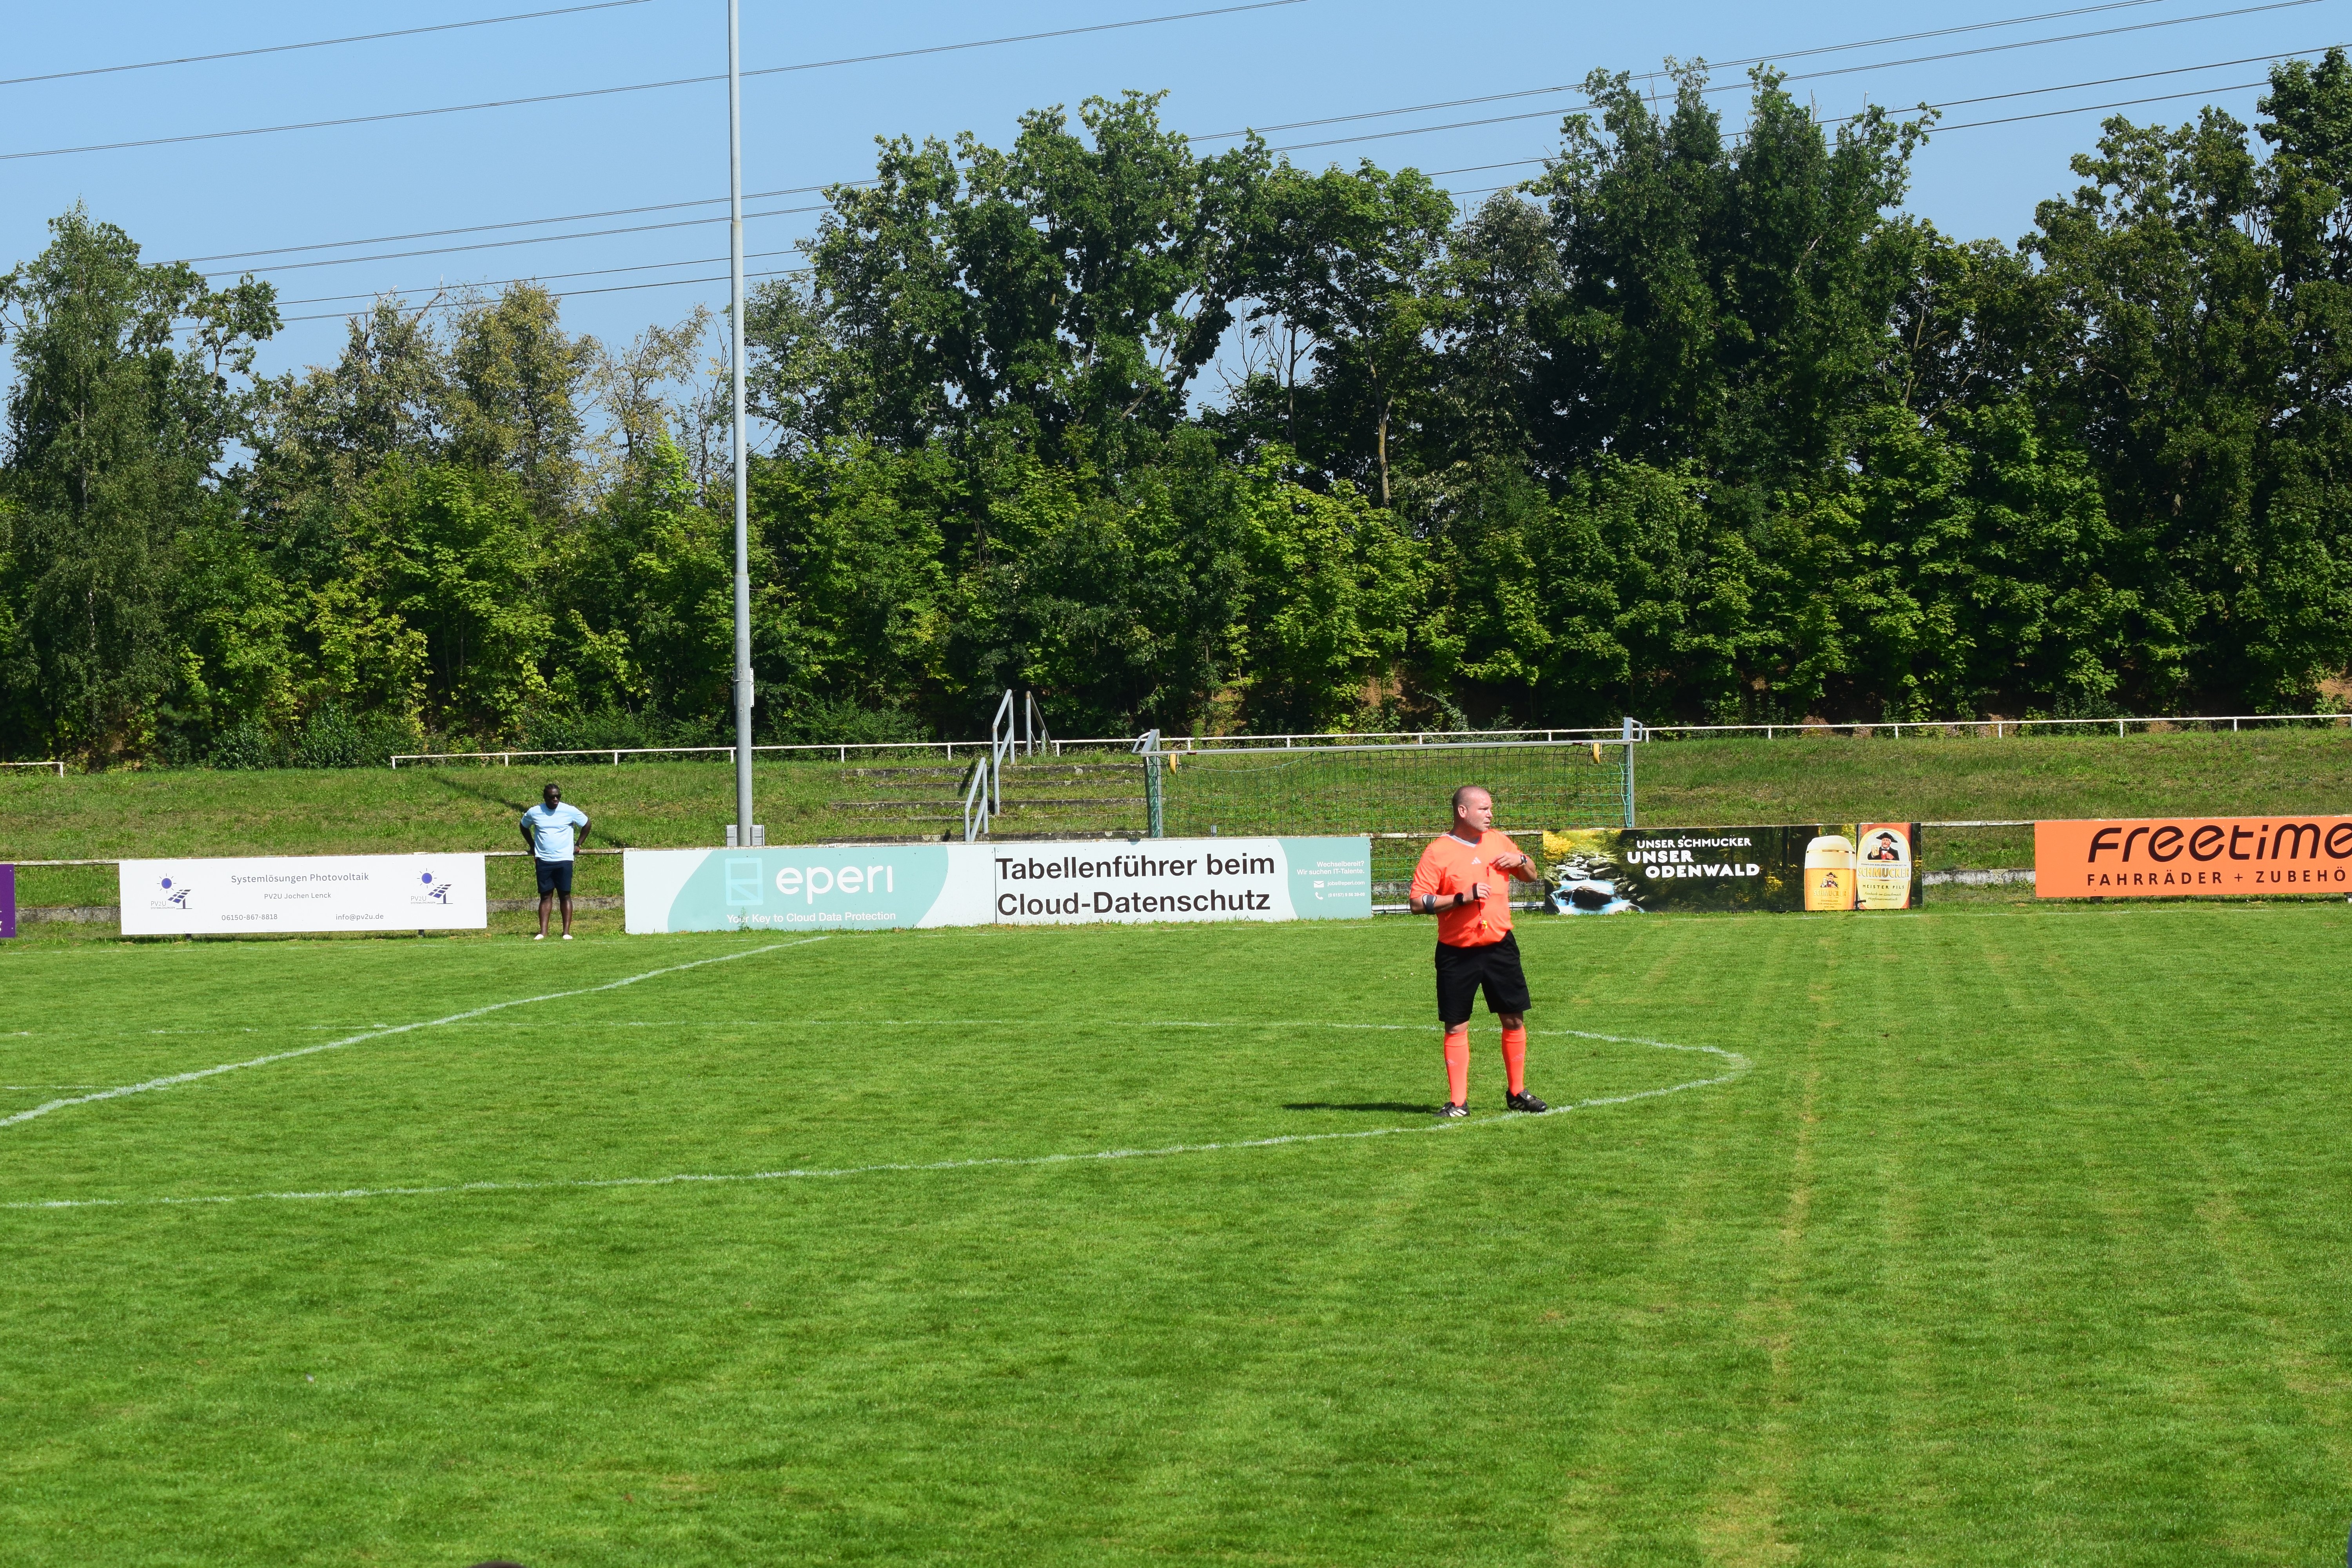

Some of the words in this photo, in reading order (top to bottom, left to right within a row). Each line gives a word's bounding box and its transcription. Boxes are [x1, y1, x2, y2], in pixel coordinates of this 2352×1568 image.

[1636, 839, 1676, 849] UNSER
[1677, 837, 1752, 848] SCHMUCKER
[1627, 850, 1695, 864] UNSER
[996, 855, 1197, 880] Tabellenführer
[1207, 853, 1274, 875] beim
[1645, 864, 1761, 878] ODENWALD
[1858, 867, 1909, 878] SCHMUCKER
[231, 875, 307, 885] Systemlösungen
[310, 872, 369, 881] Photovoltaik
[2087, 869, 2222, 886] FAHRRÄDER
[996, 889, 1270, 916] Cloud-Datenschutz
[336, 913, 384, 921] info@pv2u.de
[752, 914, 771, 925] Key
[773, 914, 784, 922] to
[786, 913, 816, 923] Cloud
[819, 913, 842, 921] Data
[845, 911, 896, 922] Protection
